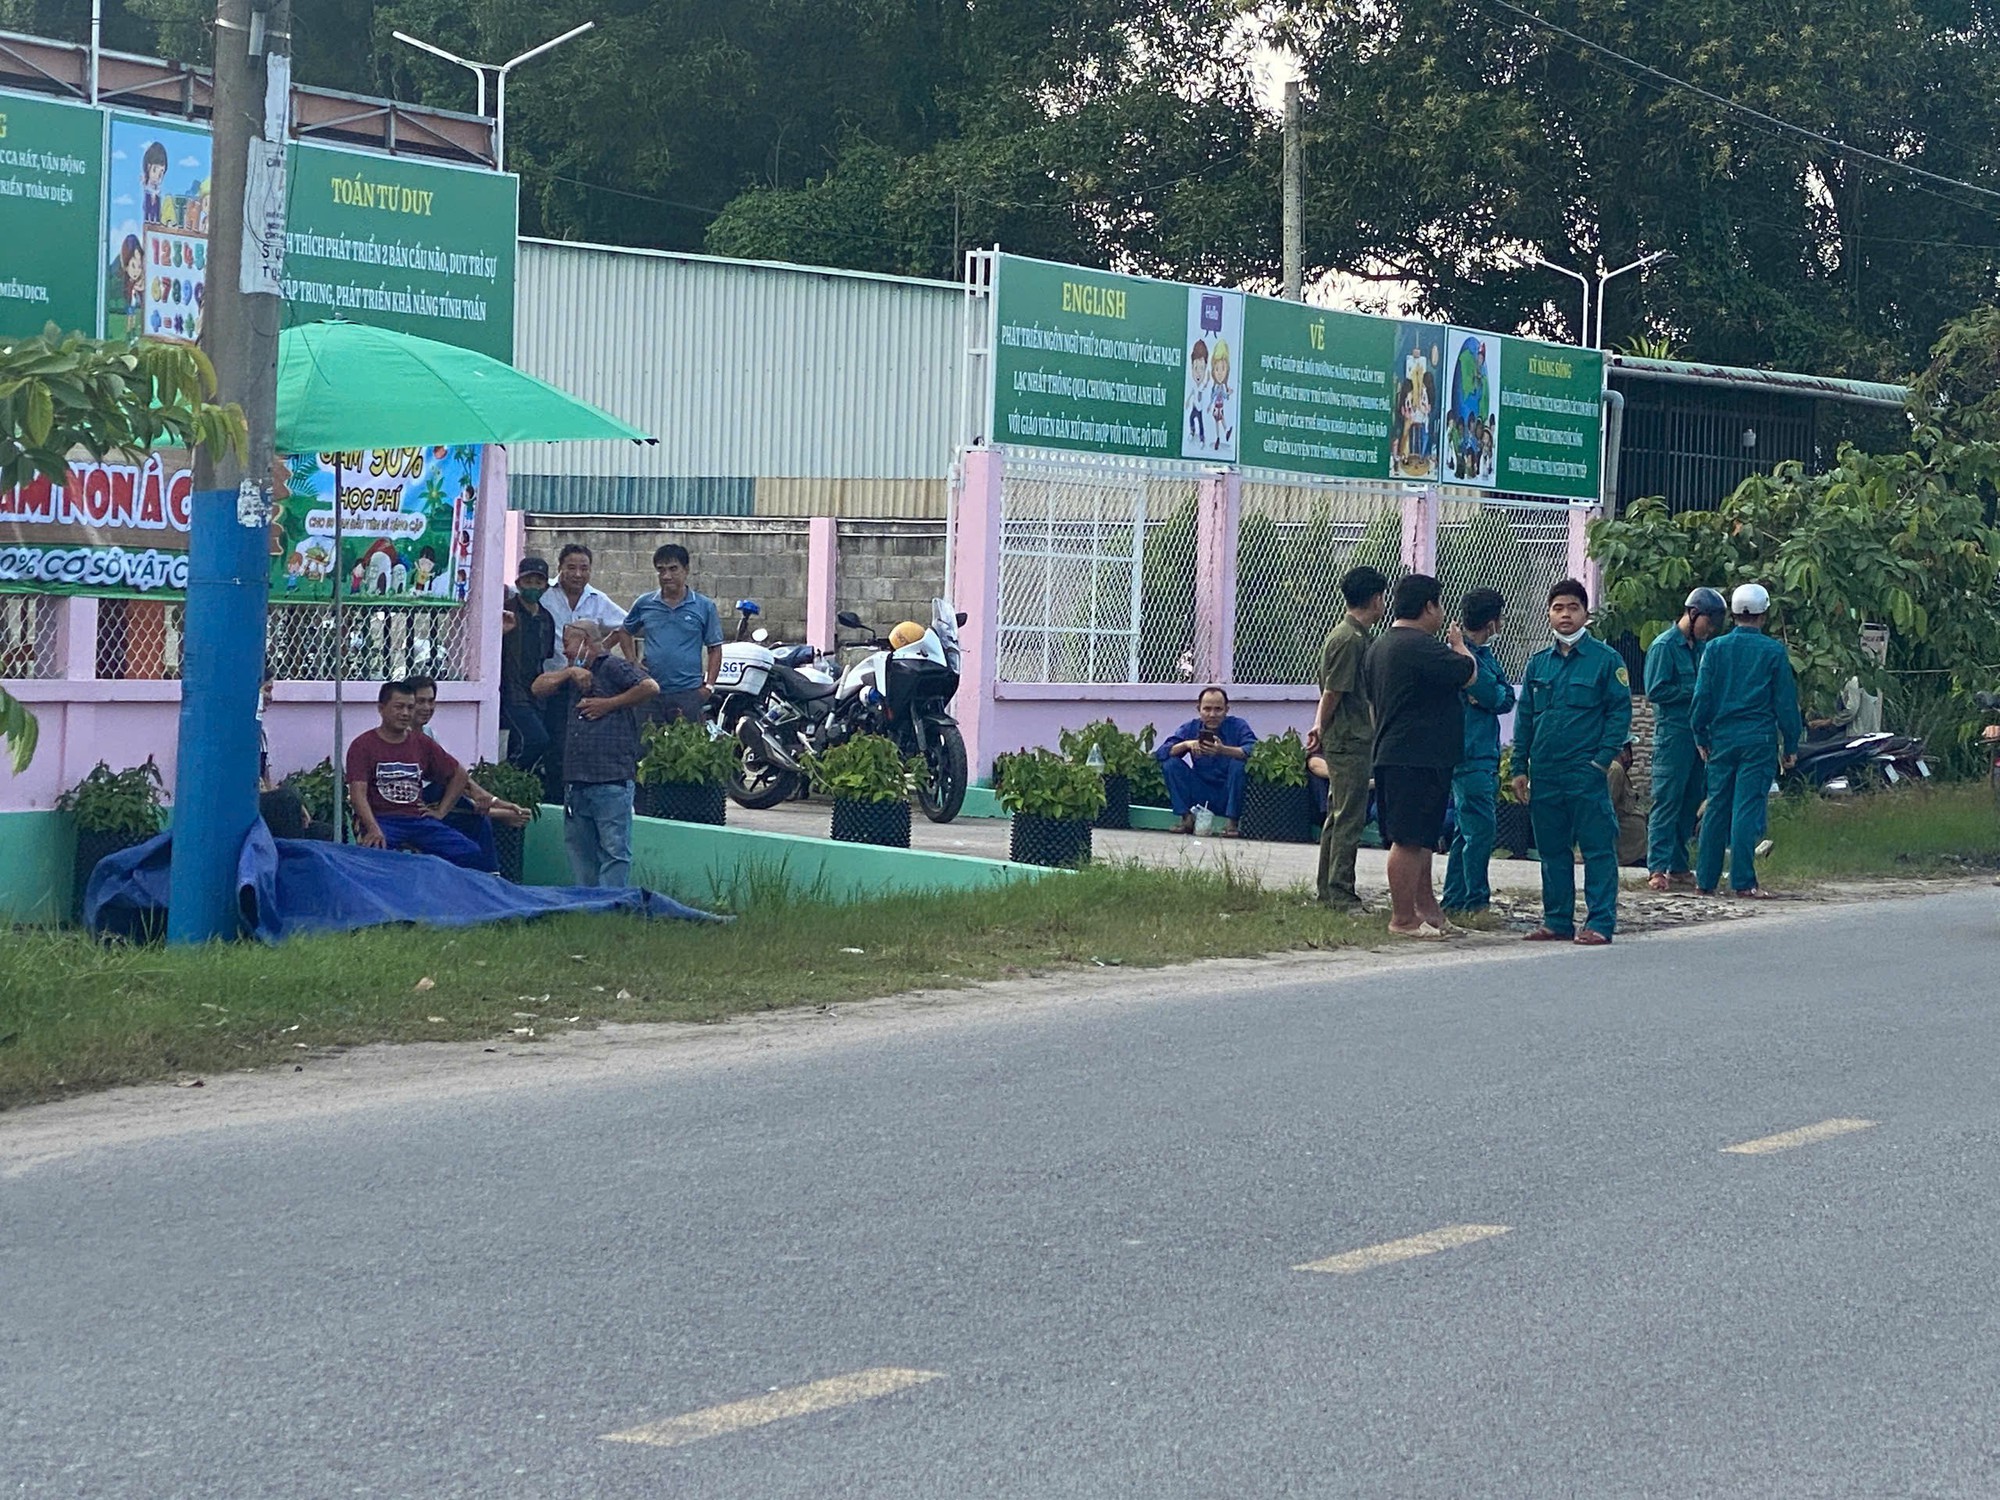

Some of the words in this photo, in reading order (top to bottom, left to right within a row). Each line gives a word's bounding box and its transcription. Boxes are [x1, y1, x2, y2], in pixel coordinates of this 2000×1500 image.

[6, 151, 18, 165] CA
[19, 148, 40, 171] HÁT,
[41, 151, 59, 174] VẬN
[60, 154, 86, 177] ĐỘNG
[25, 179, 50, 200] TOÀN
[51, 184, 73, 206] DIỆN
[331, 172, 374, 208] TOÁN
[377, 184, 400, 211] TƯ
[401, 188, 434, 216] DUY
[295, 228, 325, 258] THÍCH
[326, 231, 351, 260] PHÁT
[351, 233, 382, 264] TRIỂN
[382, 245, 388, 265] 2
[389, 239, 408, 267] BÁN
[409, 241, 427, 270] CẦU
[428, 246, 449, 277] NÃO,
[450, 253, 468, 275] DUY
[468, 249, 484, 277] TRÌ
[485, 255, 498, 285] SỰ
[25, 284, 49, 304] DỊCH,
[299, 280, 335, 310] TRUNG,
[336, 279, 362, 308] PHÁT
[362, 281, 391, 311] TRIỂN
[392, 284, 413, 314] KHẢ
[413, 288, 438, 317] NĂNG
[439, 290, 462, 319] TÍNH
[462, 294, 487, 321] TOÁN
[1062, 282, 1126, 320] ENGLISH
[1001, 320, 1020, 346] PHÁT
[1020, 320, 1043, 349] TRIỂN
[1043, 325, 1064, 351] NGÔN
[1079, 330, 1094, 356] THỨ
[1094, 338, 1099, 357] 2
[1099, 338, 1114, 358] CHO
[1114, 340, 1128, 360] CON
[1128, 338, 1144, 368] MỘT
[1144, 339, 1161, 364] CÁCH
[1161, 346, 1181, 372] MẠCH
[1013, 370, 1027, 397] LẠC
[1027, 366, 1047, 393] NHẤT
[1048, 370, 1072, 396] THÔNG
[1072, 378, 1086, 401] QUA
[1115, 377, 1137, 403] TRÌNH
[1137, 385, 1152, 405] ANH
[1152, 382, 1167, 407] VĂN
[1008, 406, 1020, 435] VỚI
[1021, 408, 1038, 436] GIÁO
[1038, 411, 1055, 437] VIÊN
[1055, 411, 1070, 438] BẢN
[1081, 415, 1094, 441] PHÙ
[1110, 418, 1122, 443] VỚI
[62, 466, 133, 520] NON
[340, 486, 374, 515] HỌC
[373, 484, 404, 512] PHÍ
[45, 555, 88, 575] CƠ
[89, 552, 121, 578] SỞ
[127, 554, 169, 584] VẬT
